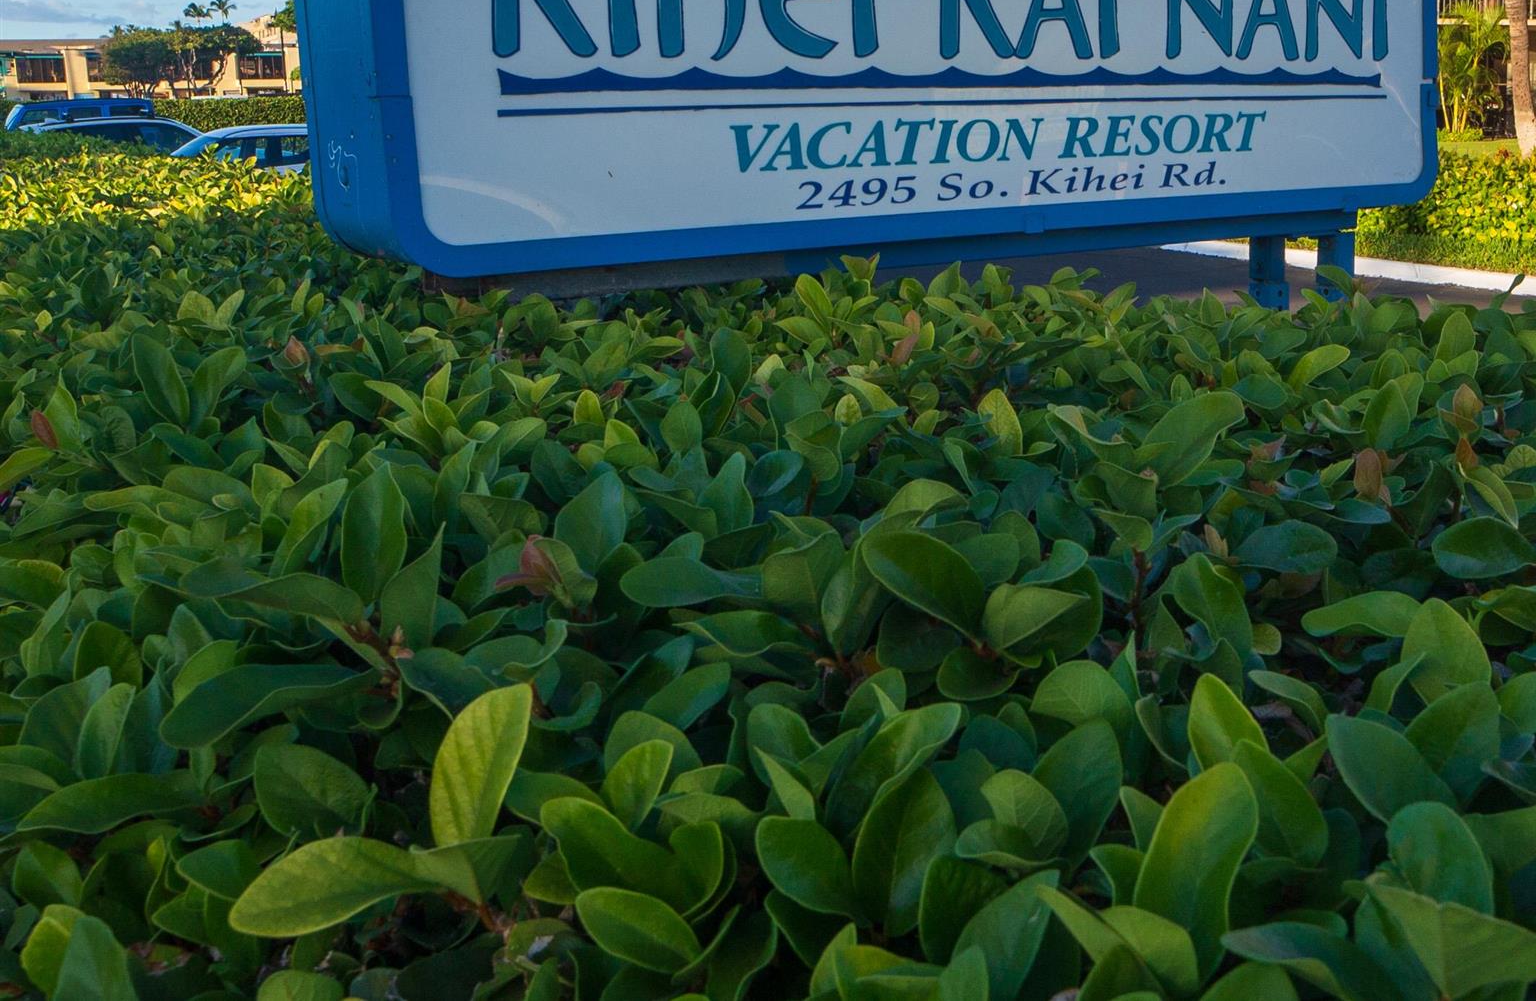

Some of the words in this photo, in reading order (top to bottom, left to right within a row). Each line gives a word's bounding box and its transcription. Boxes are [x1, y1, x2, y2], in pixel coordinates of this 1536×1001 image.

[729, 118, 1045, 174] VACATION
[1058, 110, 1267, 160] RESORT
[796, 176, 917, 210] 2495
[937, 173, 1009, 202] So.
[1025, 163, 1145, 196] Kihei
[1159, 161, 1227, 189] Rd.
